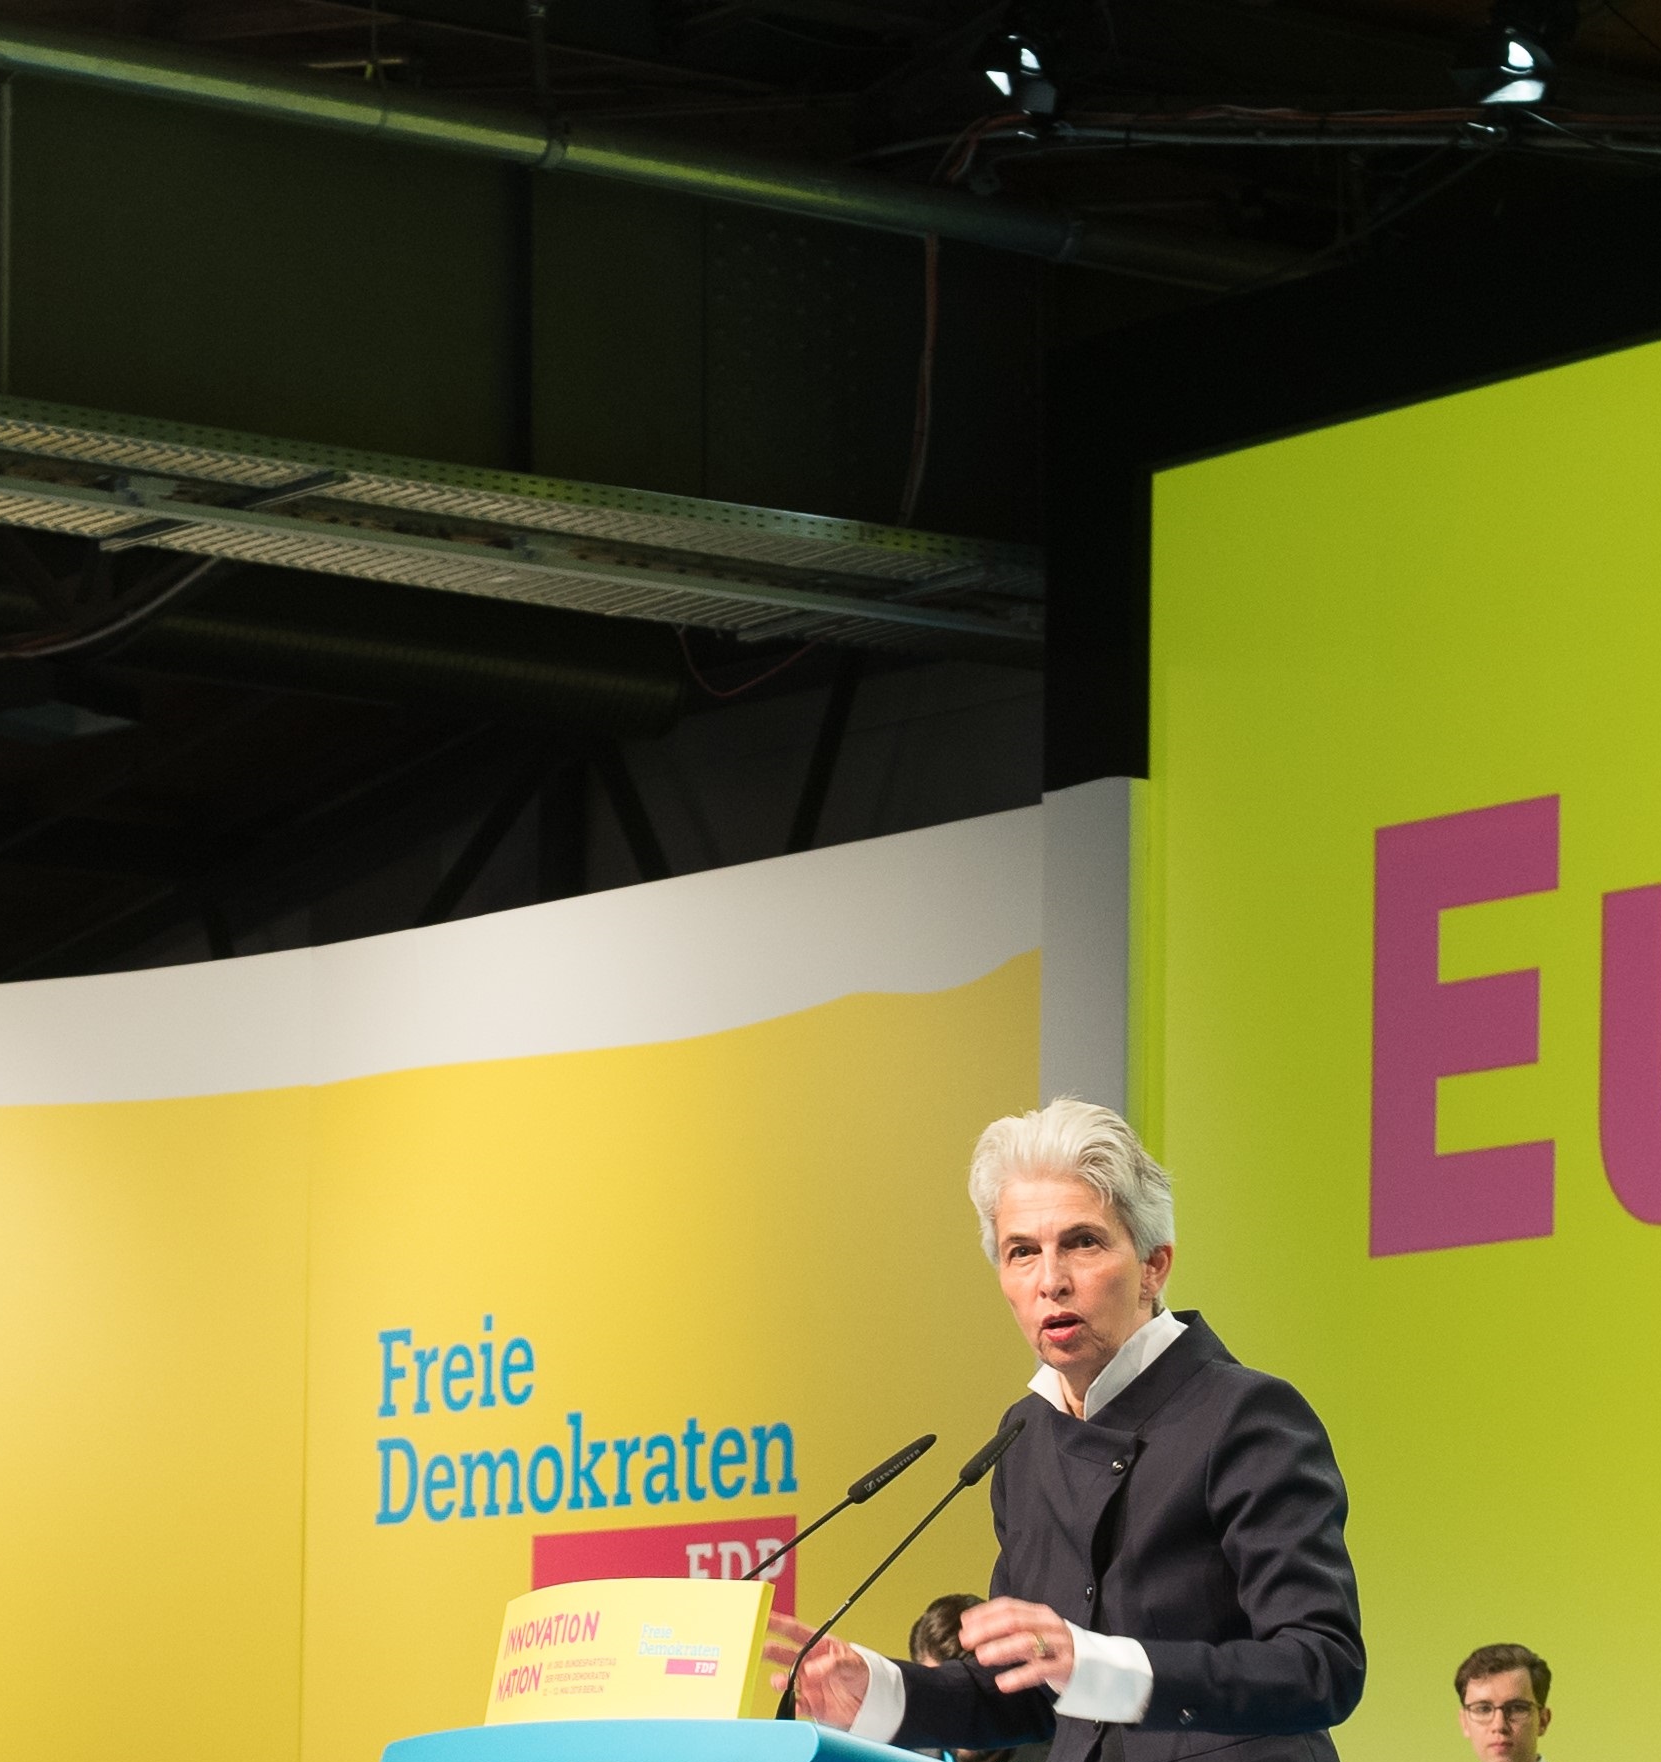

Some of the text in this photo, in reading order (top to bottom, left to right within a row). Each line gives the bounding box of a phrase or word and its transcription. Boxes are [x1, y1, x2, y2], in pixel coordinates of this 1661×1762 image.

[378, 1314, 536, 1418] Freie
[376, 1412, 798, 1525] Demokraten
[686, 1538, 786, 1581] FDP
[504, 1610, 601, 1660] INNOVATION
[638, 1641, 720, 1657] Demokraten
[642, 1624, 673, 1639] Freie
[496, 1662, 543, 1702] NATION
[694, 1663, 716, 1674] FDP
